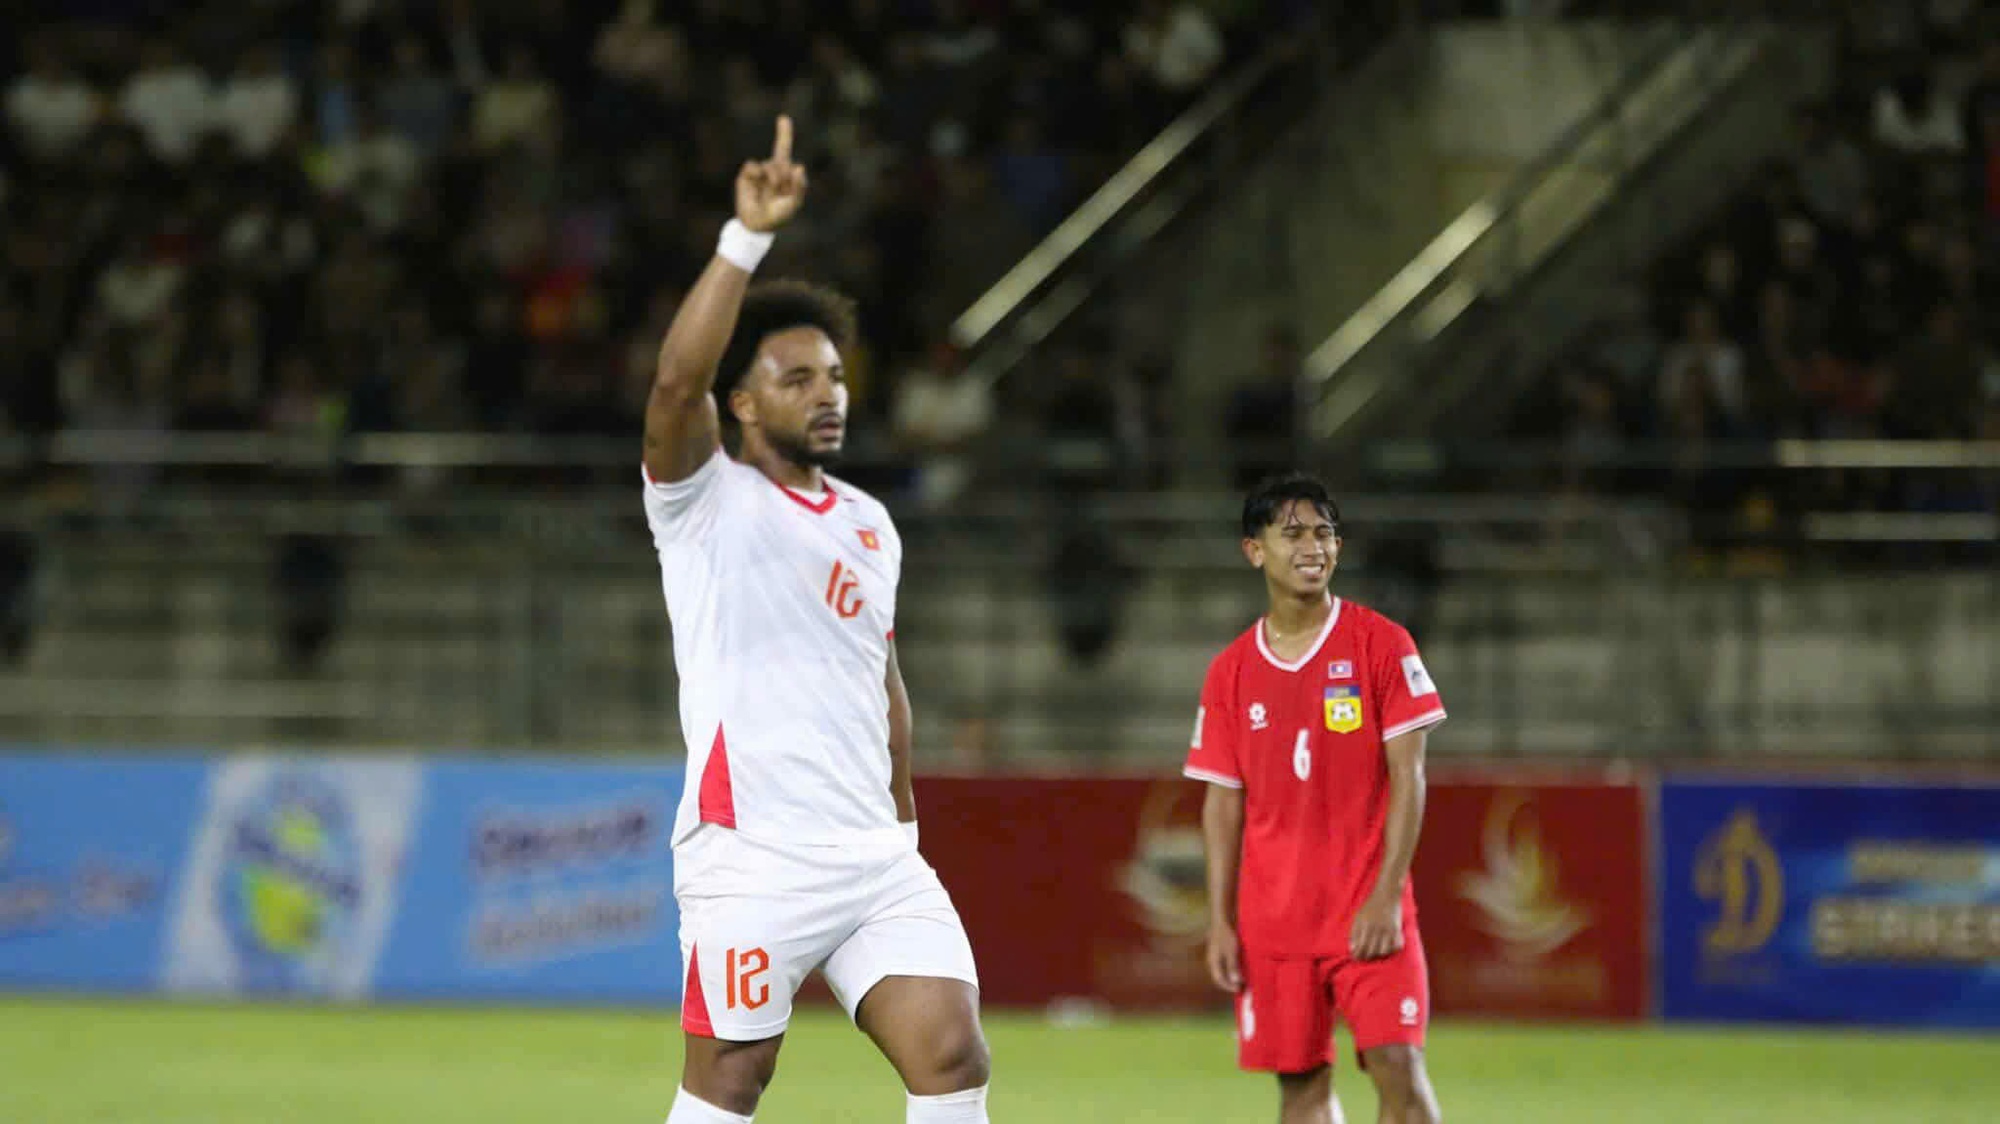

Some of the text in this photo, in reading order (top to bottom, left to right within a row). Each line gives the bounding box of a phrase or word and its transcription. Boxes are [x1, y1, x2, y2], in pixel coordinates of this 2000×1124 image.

[826, 559, 864, 619] 12
[1293, 728, 1312, 782] 6
[726, 947, 769, 1010] 12
